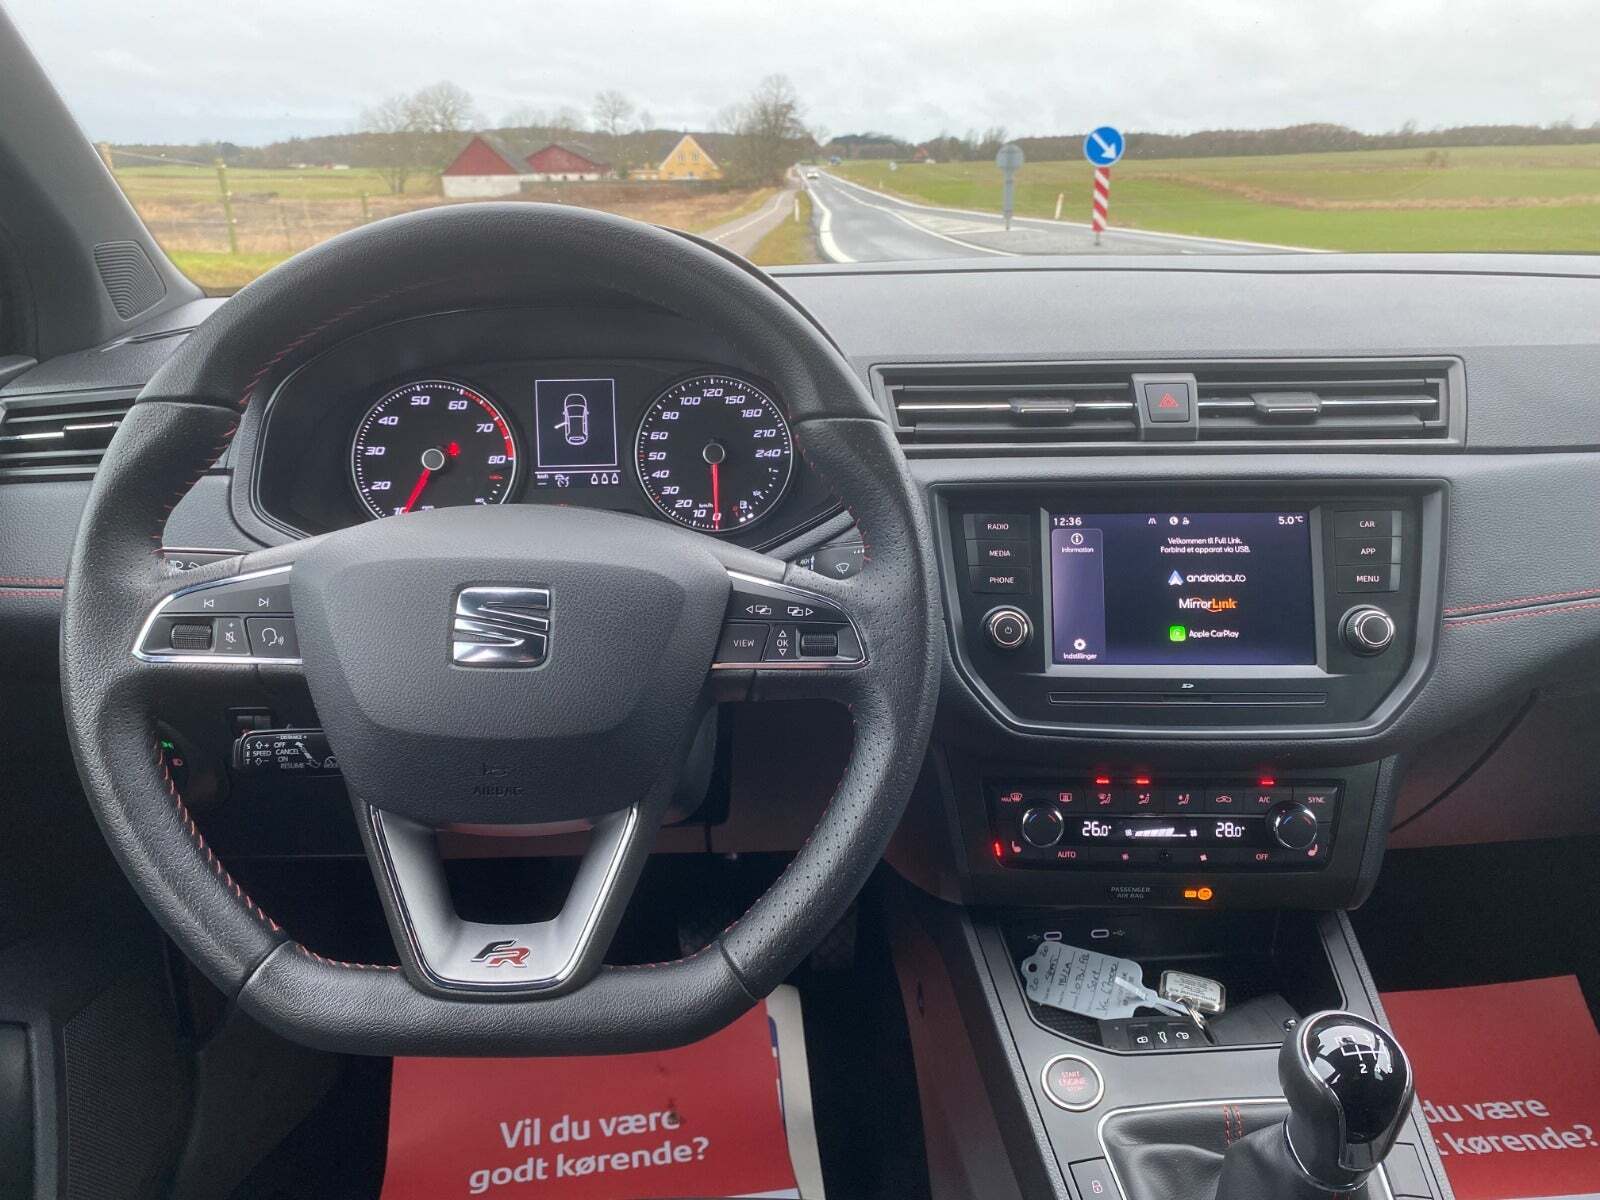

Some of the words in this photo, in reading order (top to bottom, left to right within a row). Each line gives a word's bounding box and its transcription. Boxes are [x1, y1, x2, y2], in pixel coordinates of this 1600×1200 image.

[702, 388, 723, 397] 120
[410, 395, 430, 406] 50
[679, 396, 701, 406] 100
[724, 395, 745, 404] 150
[448, 400, 468, 411] 60
[662, 411, 679, 420] 80
[741, 408, 762, 418] 180
[378, 416, 399, 426] 40
[476, 423, 494, 434] 70
[650, 431, 668, 440] 60
[753, 429, 776, 438] 210
[365, 446, 386, 456] 30
[755, 449, 781, 457] 240
[488, 455, 506, 465] 80
[648, 452, 666, 460] 50
[652, 470, 669, 478] 40
[371, 481, 392, 490] 20
[662, 486, 679, 495] 30
[675, 499, 692, 508] 20
[692, 509, 706, 518] 10
[712, 513, 722, 521] 0
[1053, 517, 1082, 526] 12:36
[1359, 520, 1375, 528] CAR
[1167, 537, 1207, 545] Velkommen
[1195, 546, 1223, 554] apparat
[1235, 545, 1251, 553] USB.
[1360, 548, 1376, 556] APP
[989, 576, 1014, 584] PHONE
[1356, 575, 1380, 583] MENU
[1178, 597, 1238, 611] MirrorLink
[1188, 630, 1210, 638] Apple
[1210, 629, 1240, 638] CarPlay
[733, 639, 755, 648] VIEW
[776, 639, 789, 647] OK
[1063, 652, 1097, 660] Indstillinger
[1258, 796, 1271, 804] A/C
[1307, 796, 1325, 804] SYNC
[1057, 851, 1076, 859] AUTO
[1255, 853, 1269, 861] OFF
[1359, 1063, 1368, 1074] 2
[1466, 1098, 1550, 1123] være
[500, 1118, 542, 1150] Vil
[549, 1113, 590, 1144] du
[599, 1110, 682, 1138] være
[1443, 1123, 1597, 1155] kørende?
[469, 1158, 549, 1195] godt
[556, 1136, 710, 1181] kørende?
